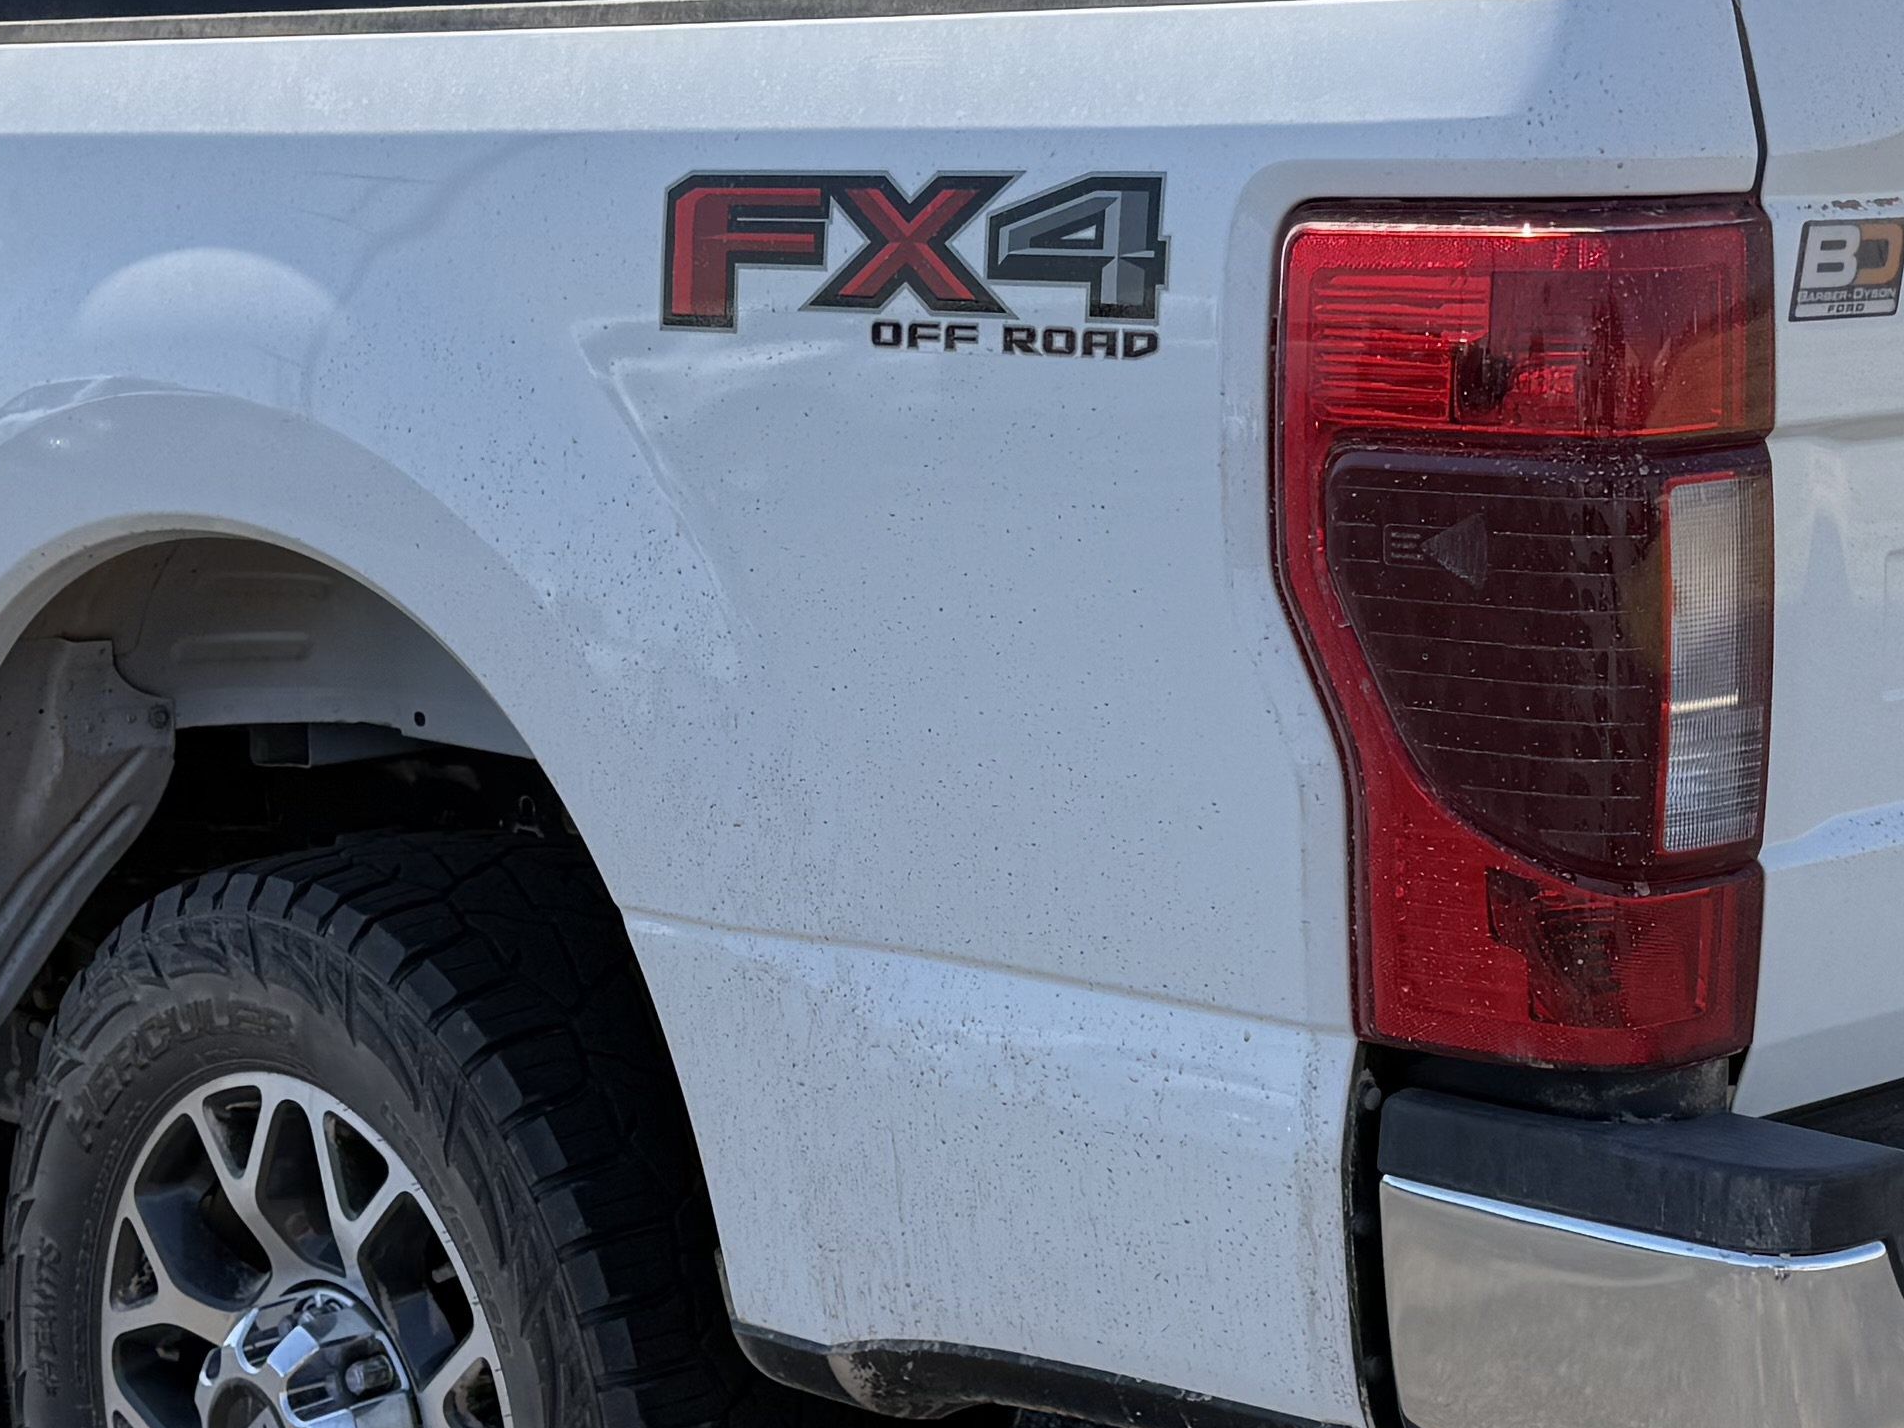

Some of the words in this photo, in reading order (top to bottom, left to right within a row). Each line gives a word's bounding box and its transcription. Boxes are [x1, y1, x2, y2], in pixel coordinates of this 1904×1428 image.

[661, 170, 1171, 333] FX4
[1828, 303, 1865, 314] FORD
[870, 319, 980, 353] OFF
[1001, 324, 1160, 360] ROAD
